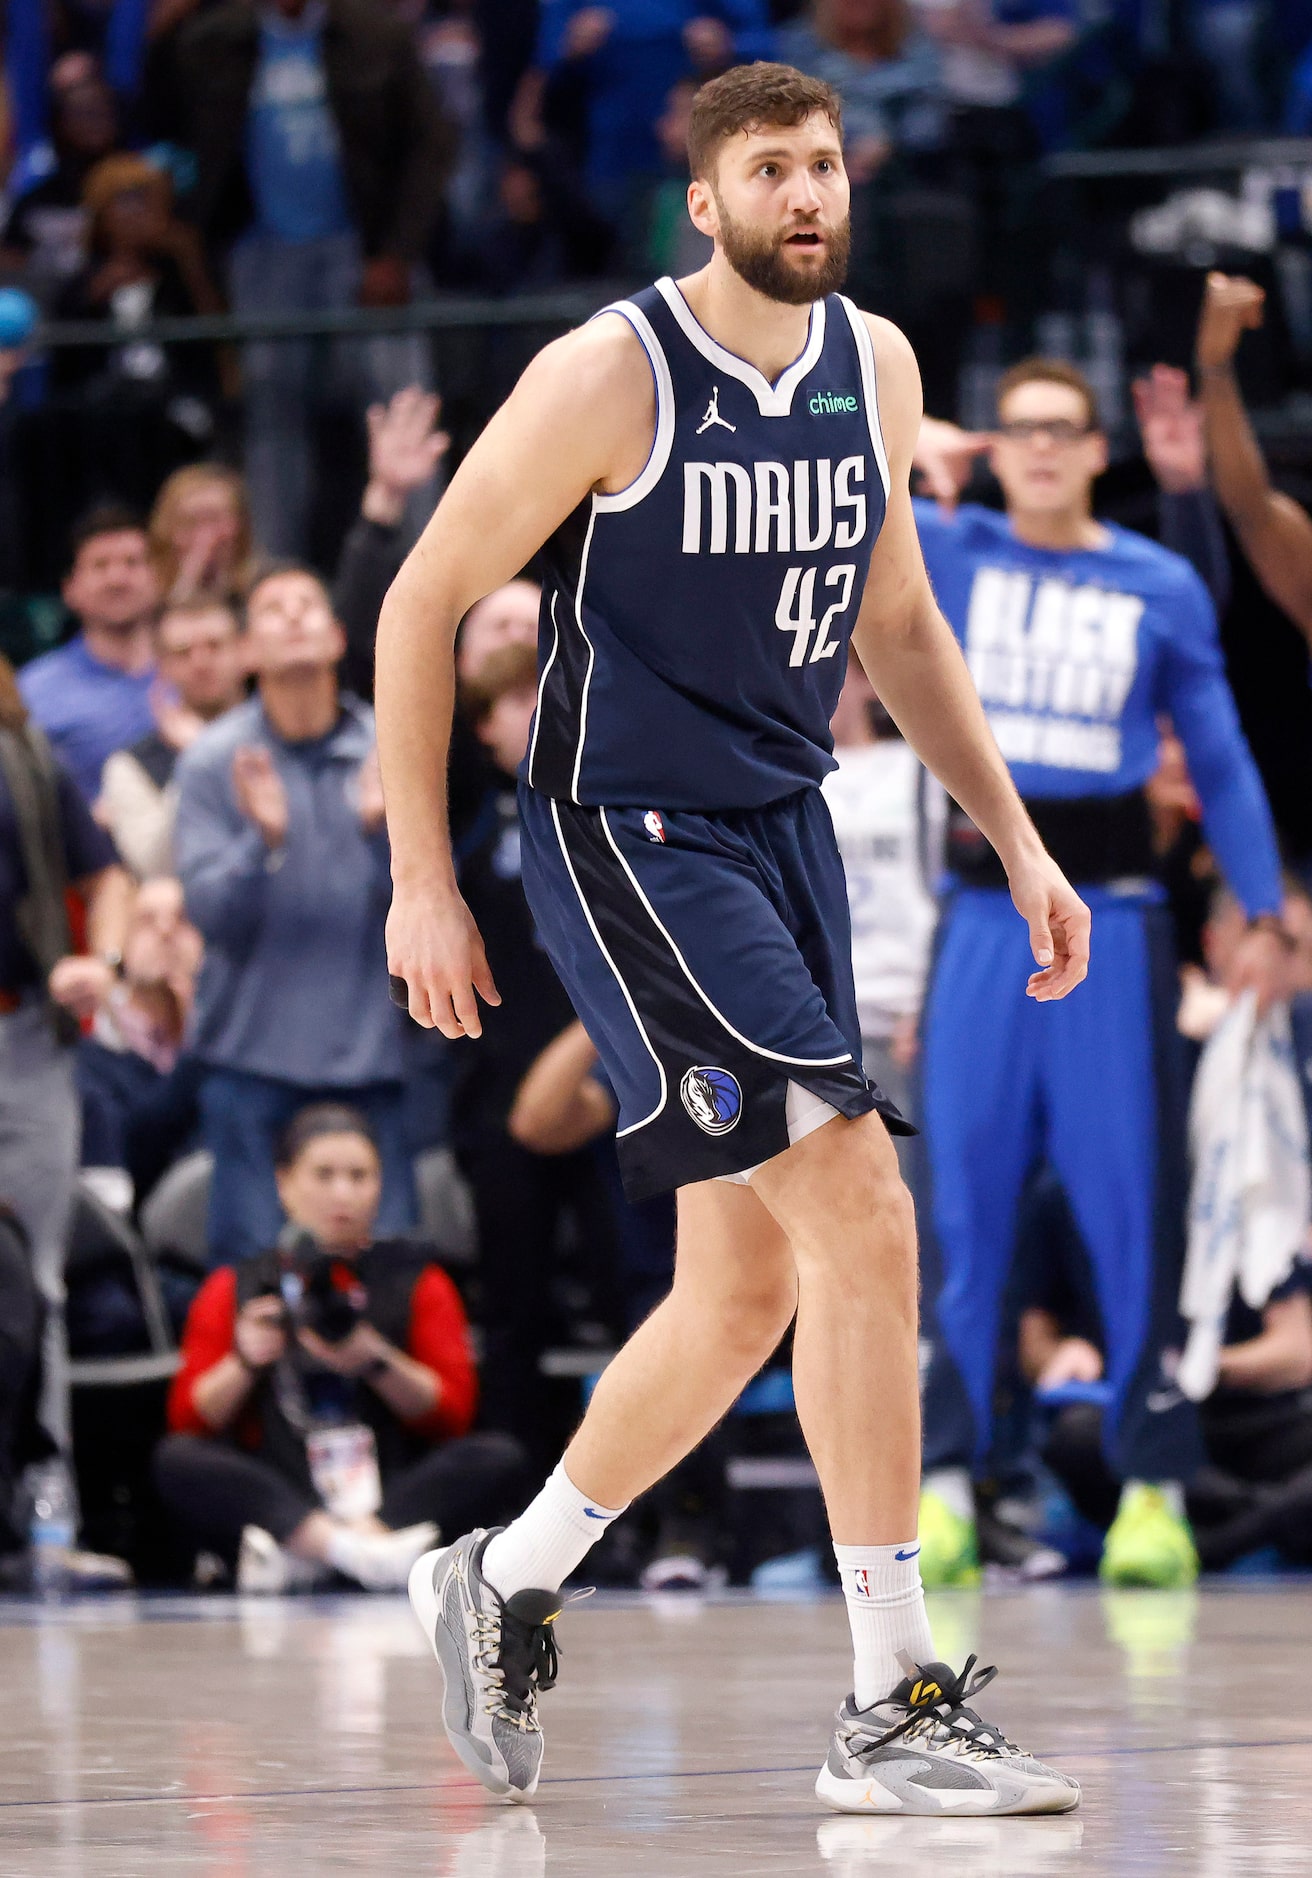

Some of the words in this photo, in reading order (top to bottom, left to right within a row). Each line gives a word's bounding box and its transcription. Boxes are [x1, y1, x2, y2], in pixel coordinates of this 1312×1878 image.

[809, 391, 858, 415] chime
[682, 455, 867, 554] MAVS
[775, 564, 857, 668] 42
[966, 566, 1145, 661] BLACK
